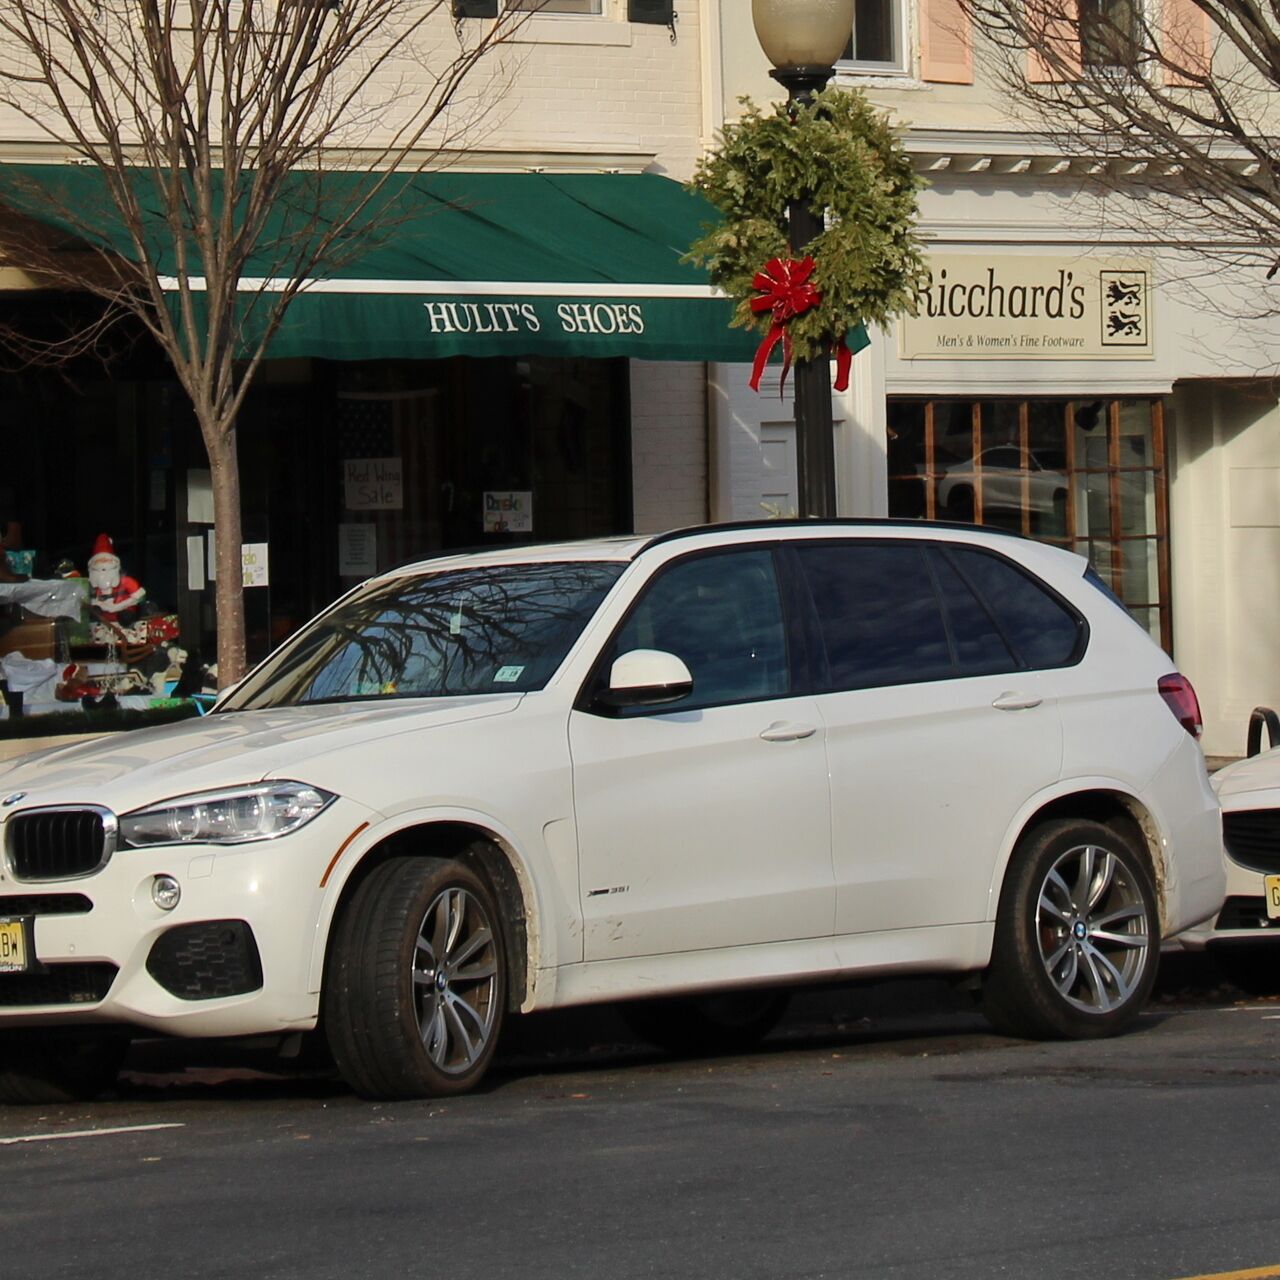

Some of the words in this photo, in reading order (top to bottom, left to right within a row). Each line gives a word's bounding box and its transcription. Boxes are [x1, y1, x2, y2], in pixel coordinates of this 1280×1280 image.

[423, 302, 540, 333] HULIT'S
[557, 303, 645, 334] SHOES
[936, 334, 963, 348] Men's
[966, 335, 974, 347] &
[976, 334, 1018, 348] Women's
[1020, 334, 1040, 348] Fine
[1042, 335, 1086, 348] Footware
[347, 463, 369, 482] Red
[374, 463, 401, 485] Wing
[357, 485, 394, 505] Sale
